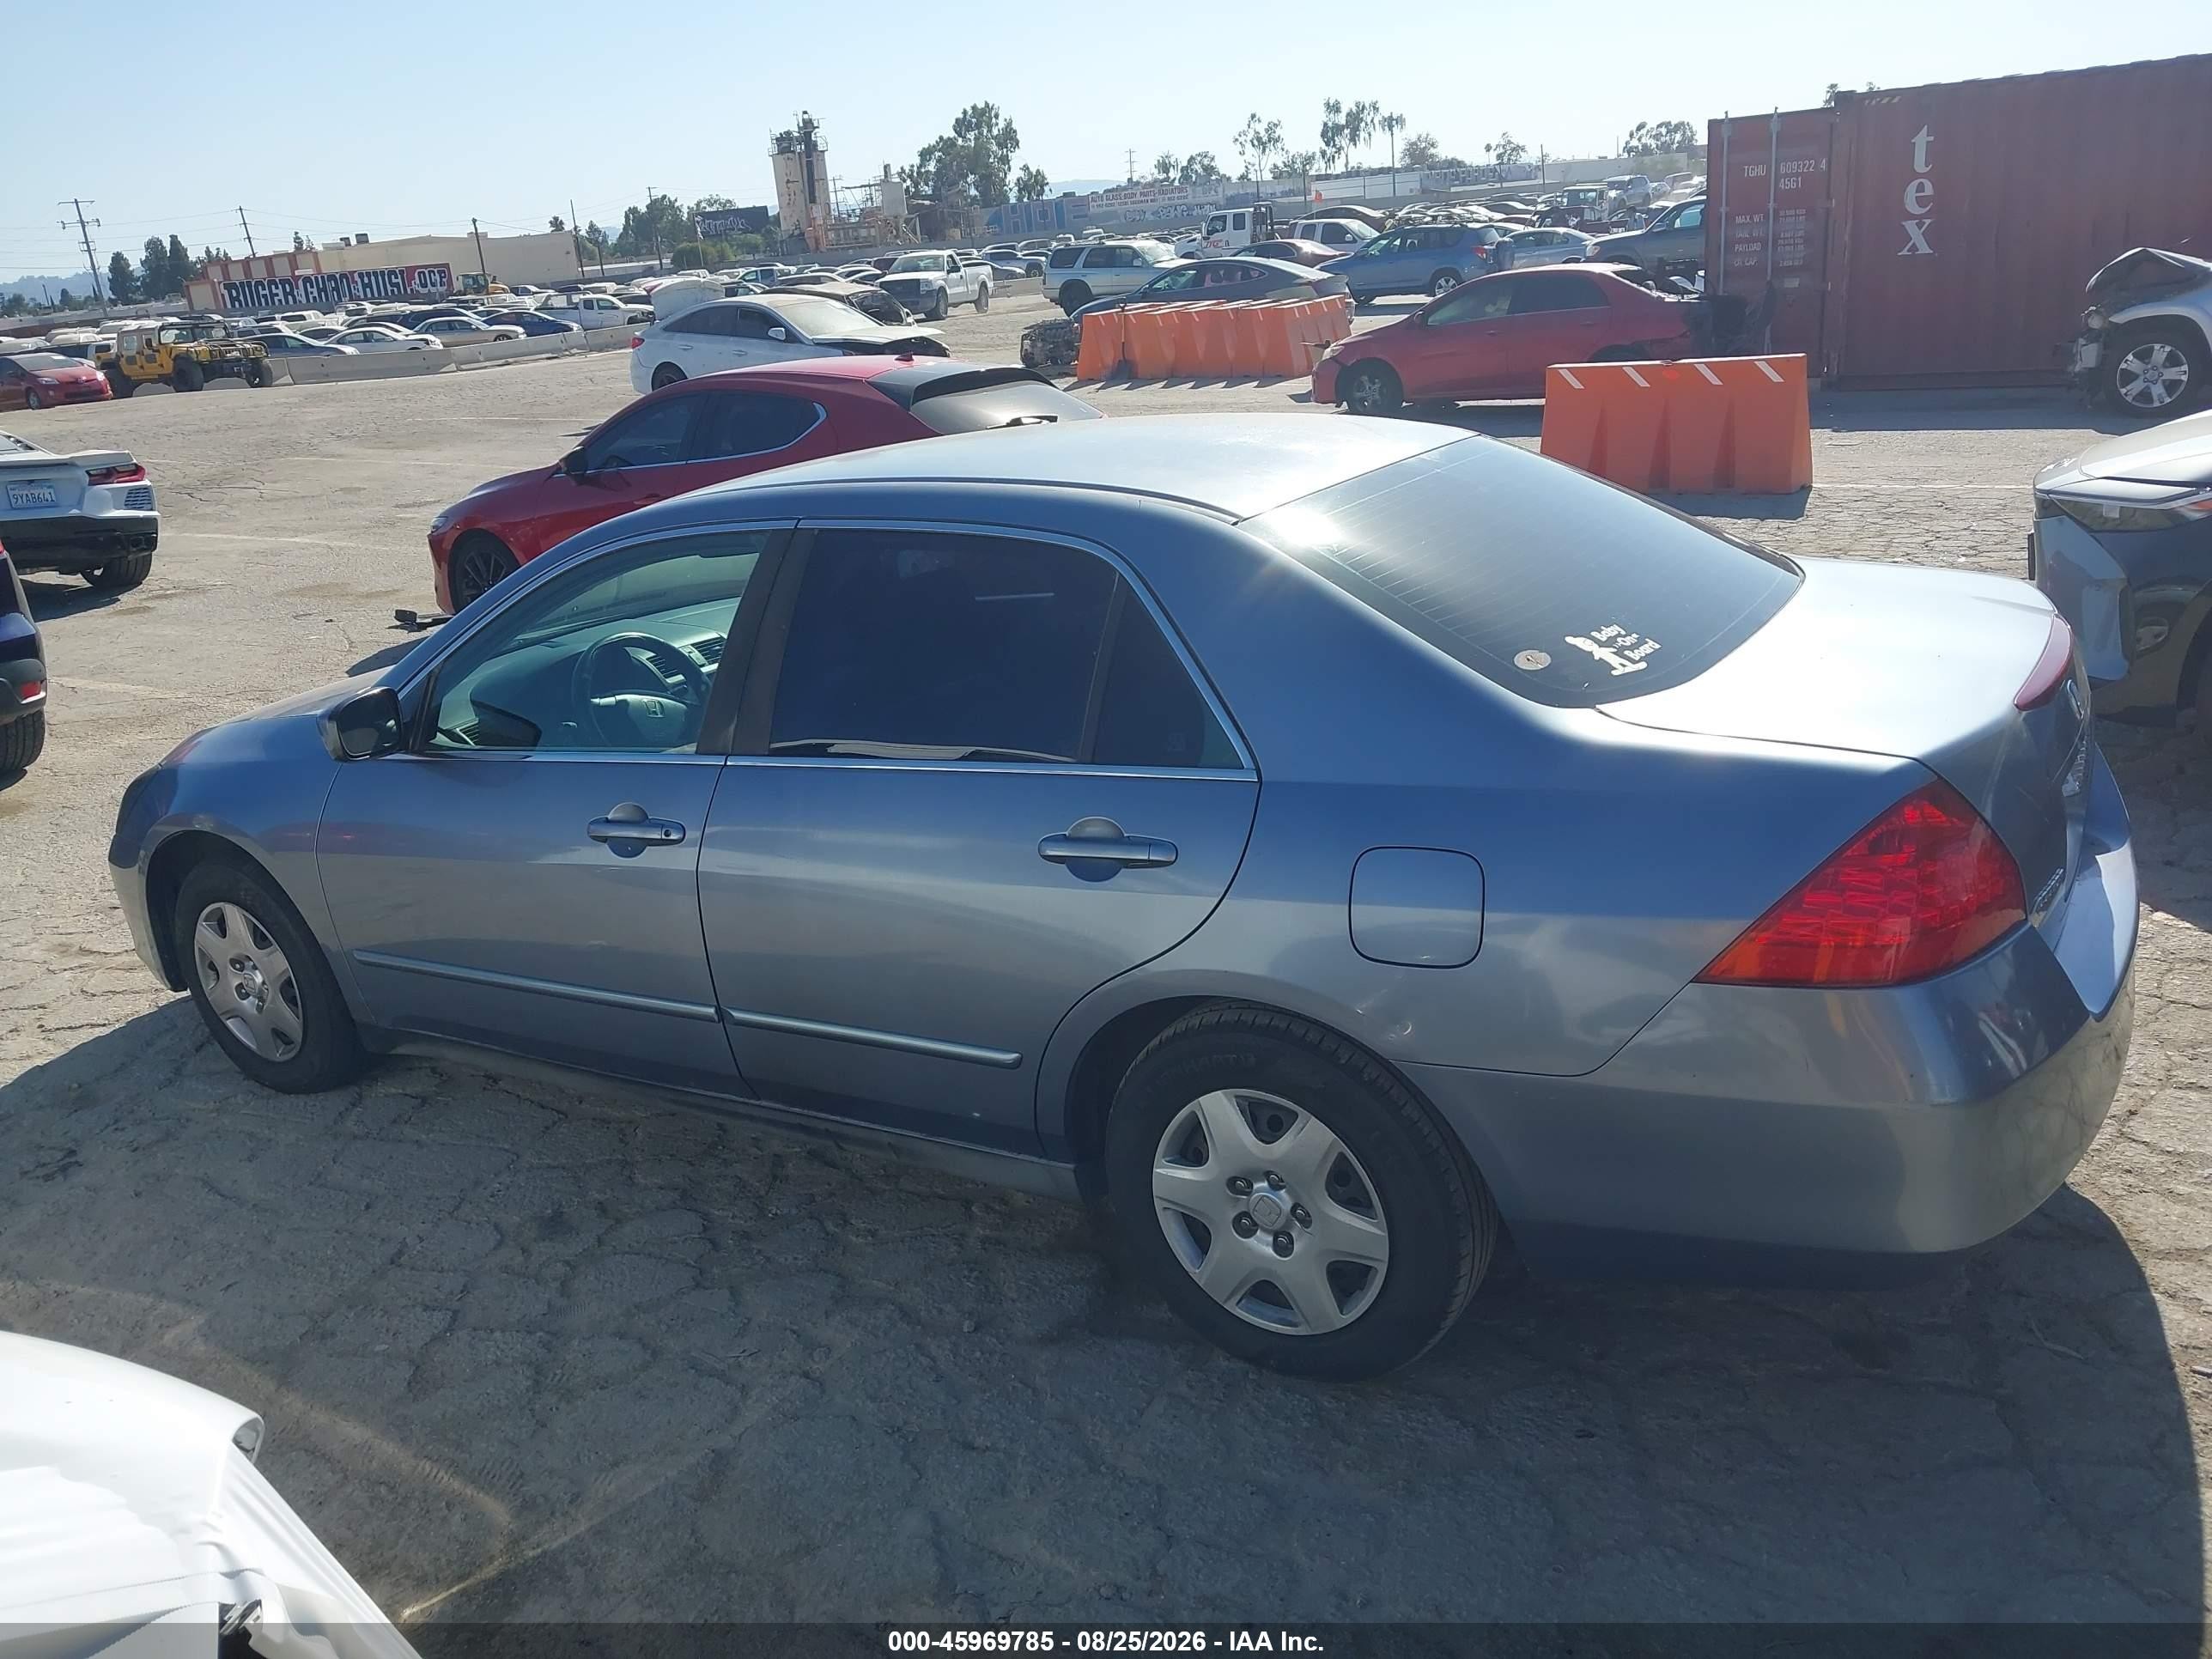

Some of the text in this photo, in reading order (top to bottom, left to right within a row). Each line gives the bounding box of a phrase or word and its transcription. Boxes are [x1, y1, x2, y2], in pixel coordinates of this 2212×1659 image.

[1743, 164, 1766, 177] TGHU
[1780, 160, 1815, 173] 609322
[1779, 176, 1802, 189] 45G1
[1896, 125, 1935, 256] tex
[1090, 194, 1104, 204] AUTO
[1735, 242, 1761, 252] PAYLOAD
[1590, 623, 1627, 642] Baby
[1623, 639, 1662, 661] Board
